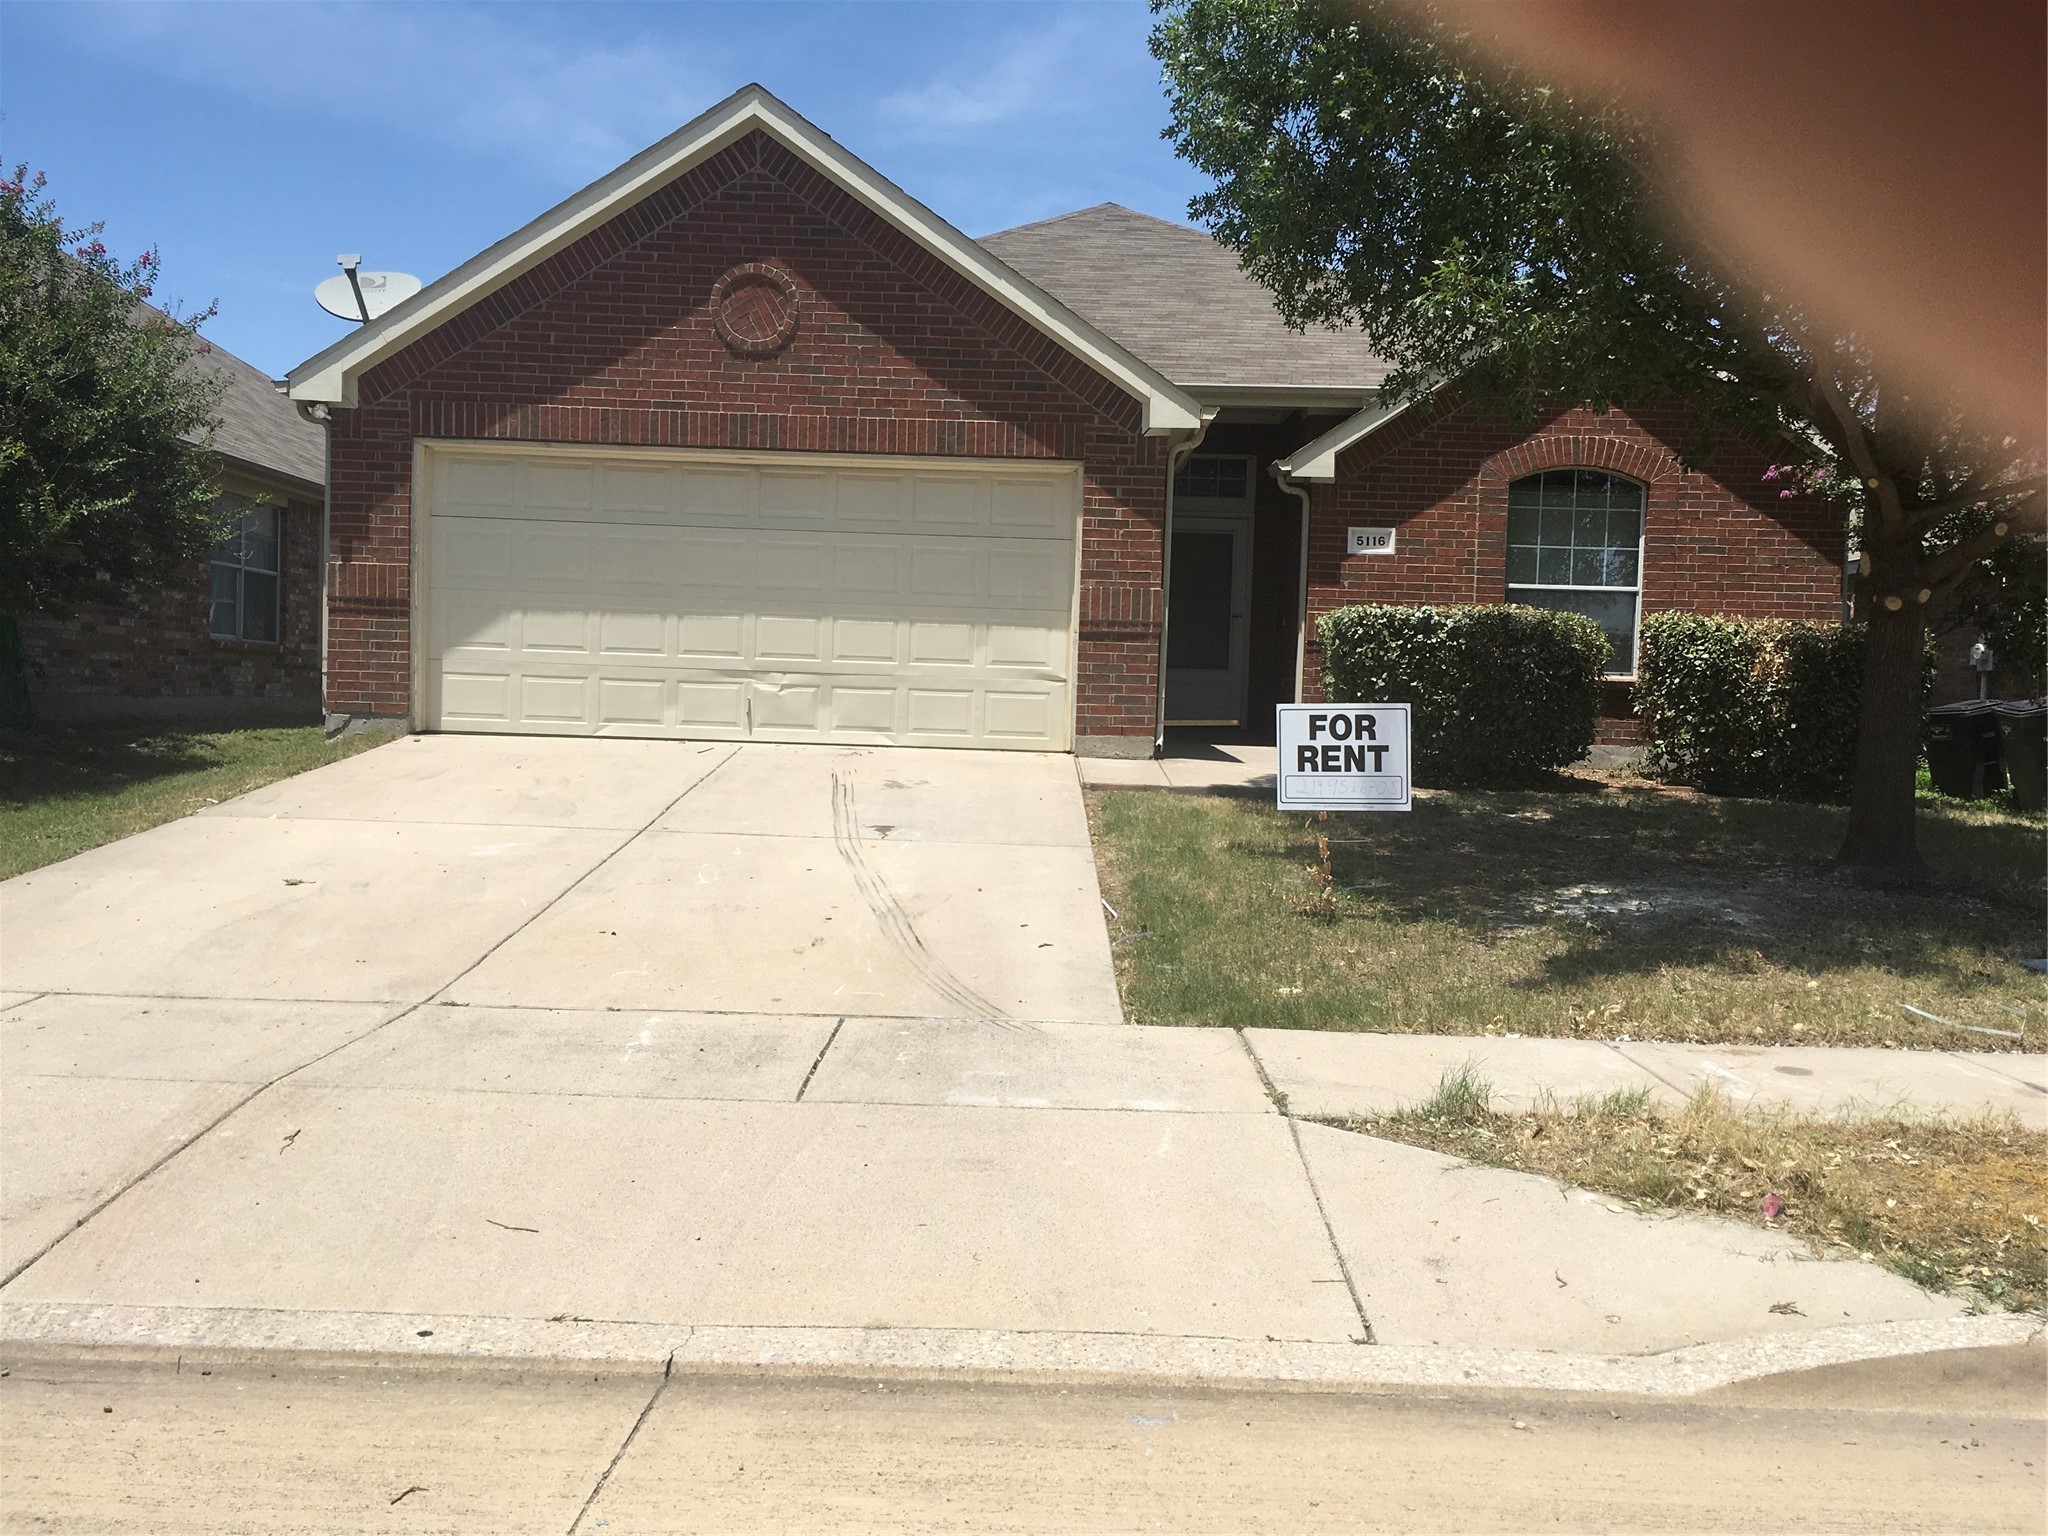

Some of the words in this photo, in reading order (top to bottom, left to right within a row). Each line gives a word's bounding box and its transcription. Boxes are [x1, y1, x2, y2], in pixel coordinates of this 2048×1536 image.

[1356, 535, 1386, 547] 5116
[1308, 713, 1377, 741] FOR
[1297, 745, 1389, 773] RENT
